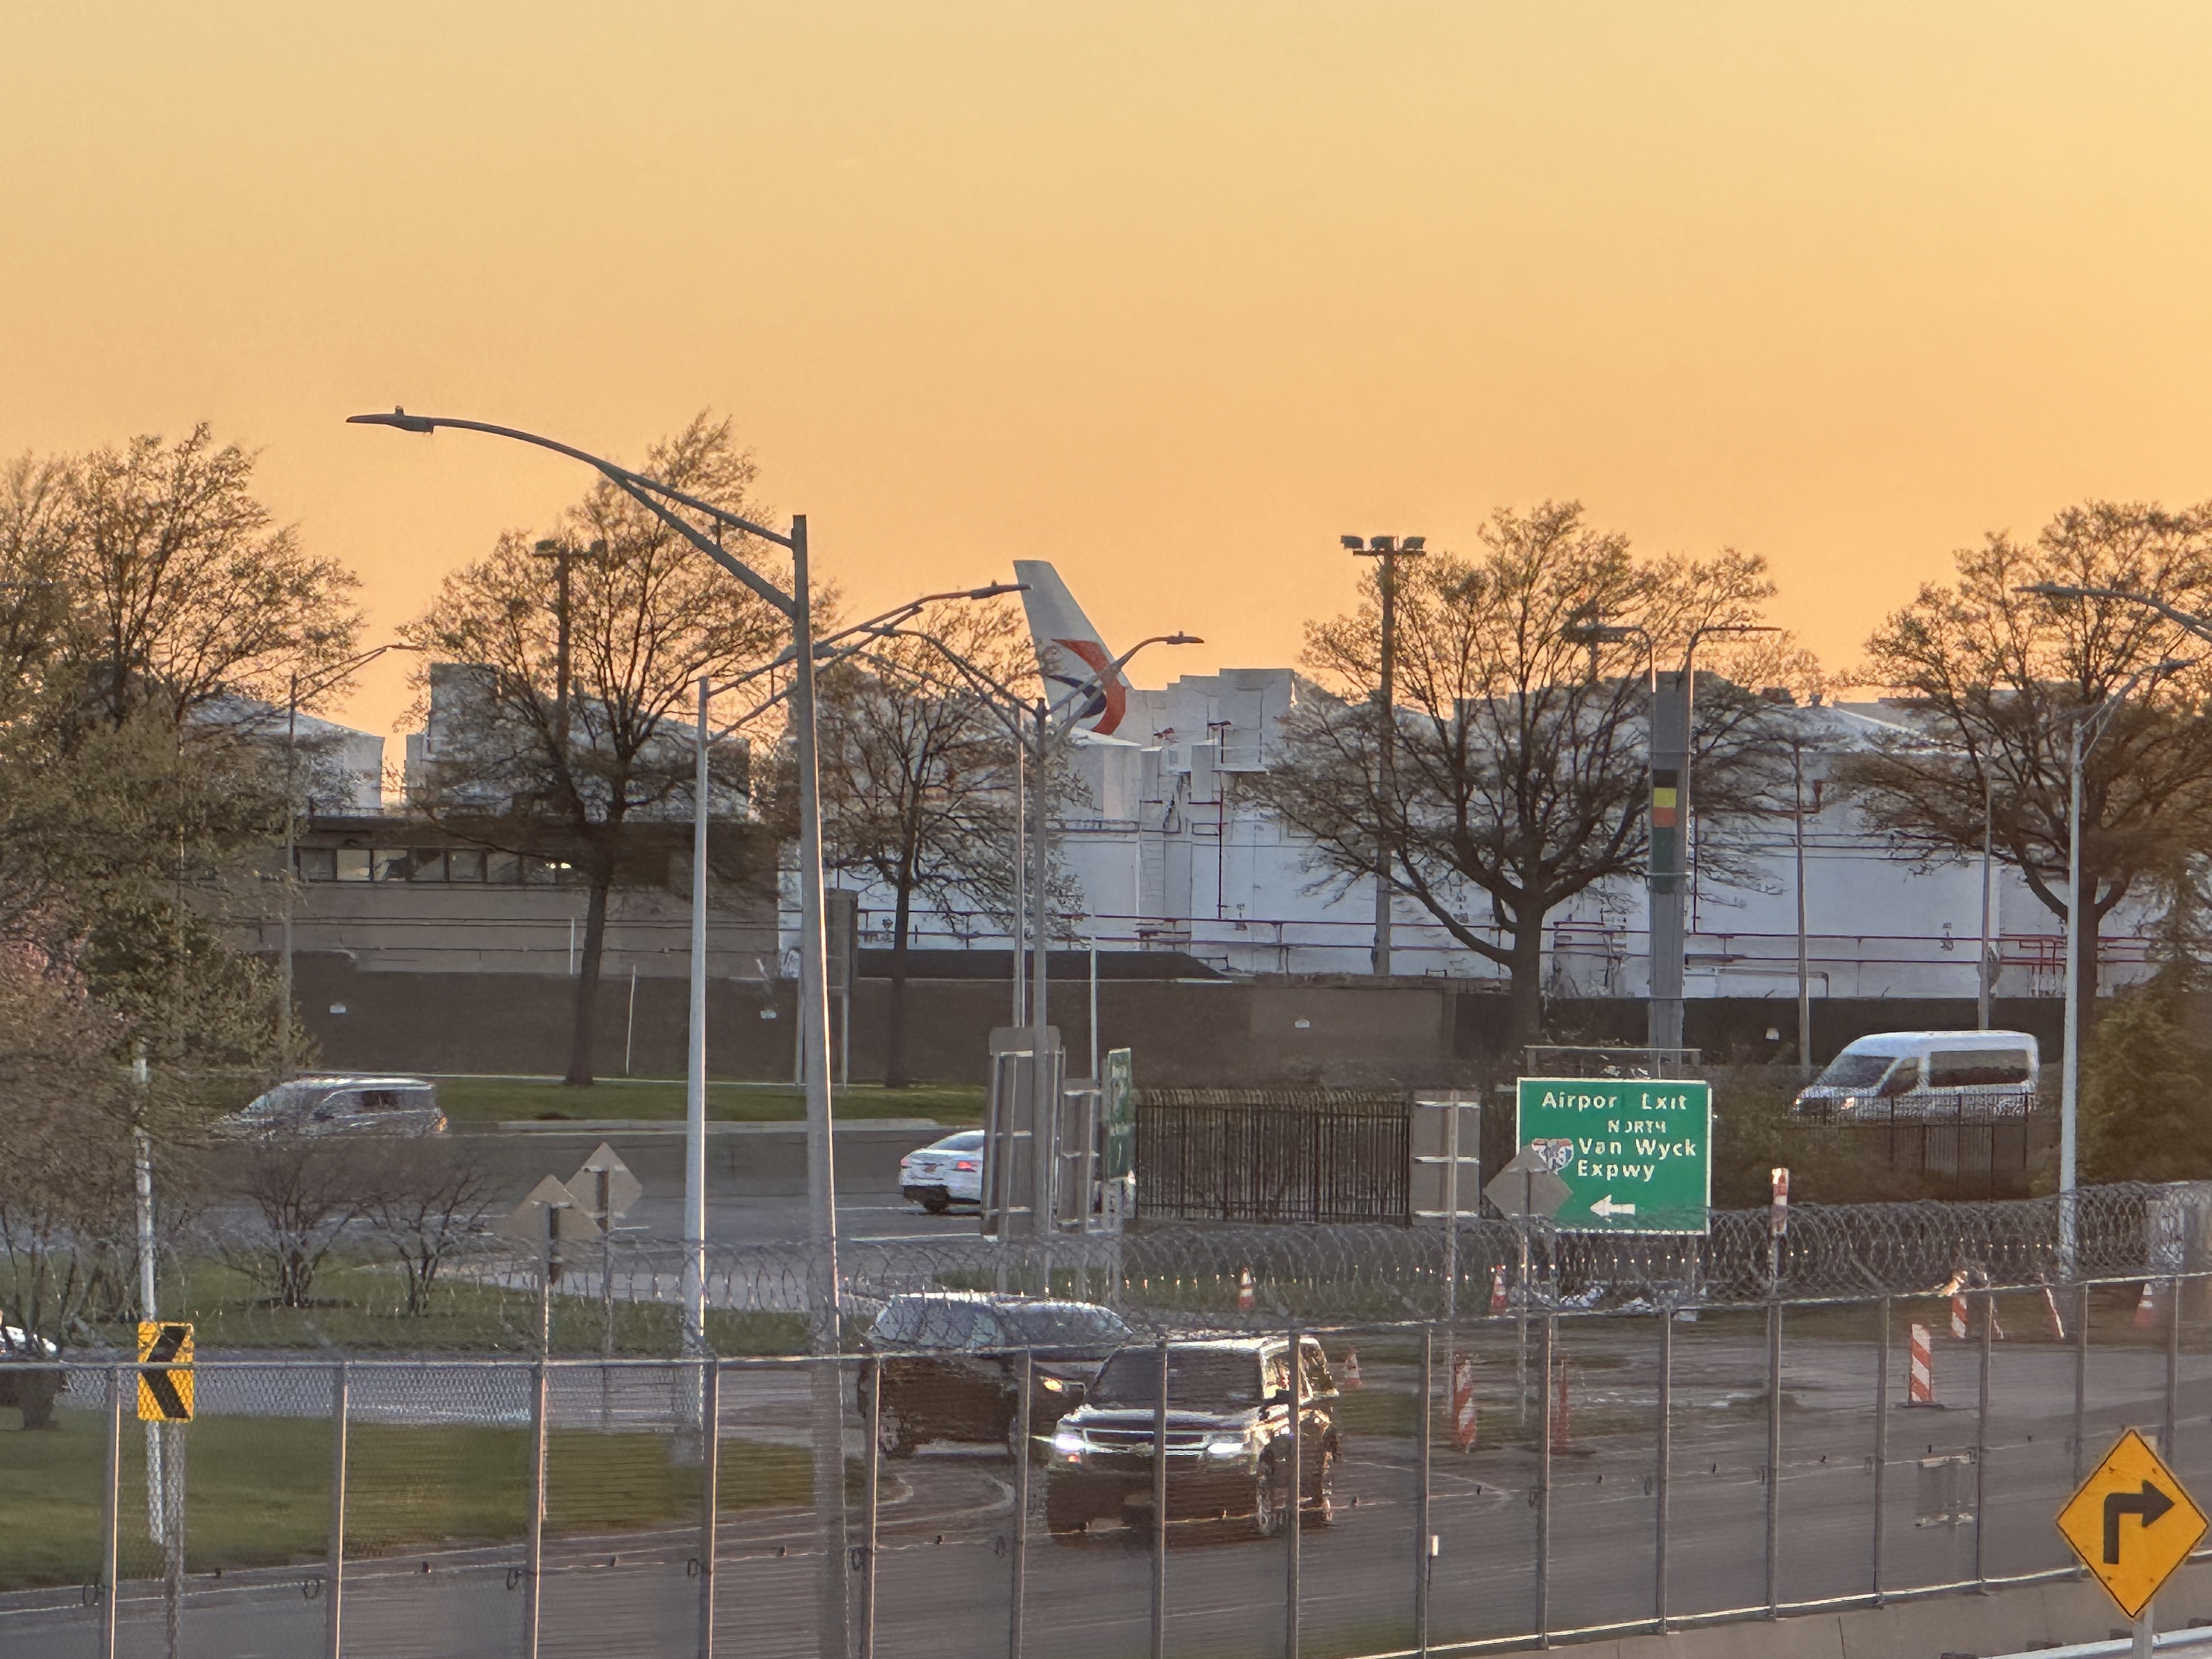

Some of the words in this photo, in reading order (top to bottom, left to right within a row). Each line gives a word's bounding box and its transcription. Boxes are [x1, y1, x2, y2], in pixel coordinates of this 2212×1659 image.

[1542, 1091, 1620, 1112] Airpor
[1578, 1137, 1622, 1155] Van
[1635, 1138, 1696, 1160] Wyck
[1577, 1159, 1655, 1182] Expwy
